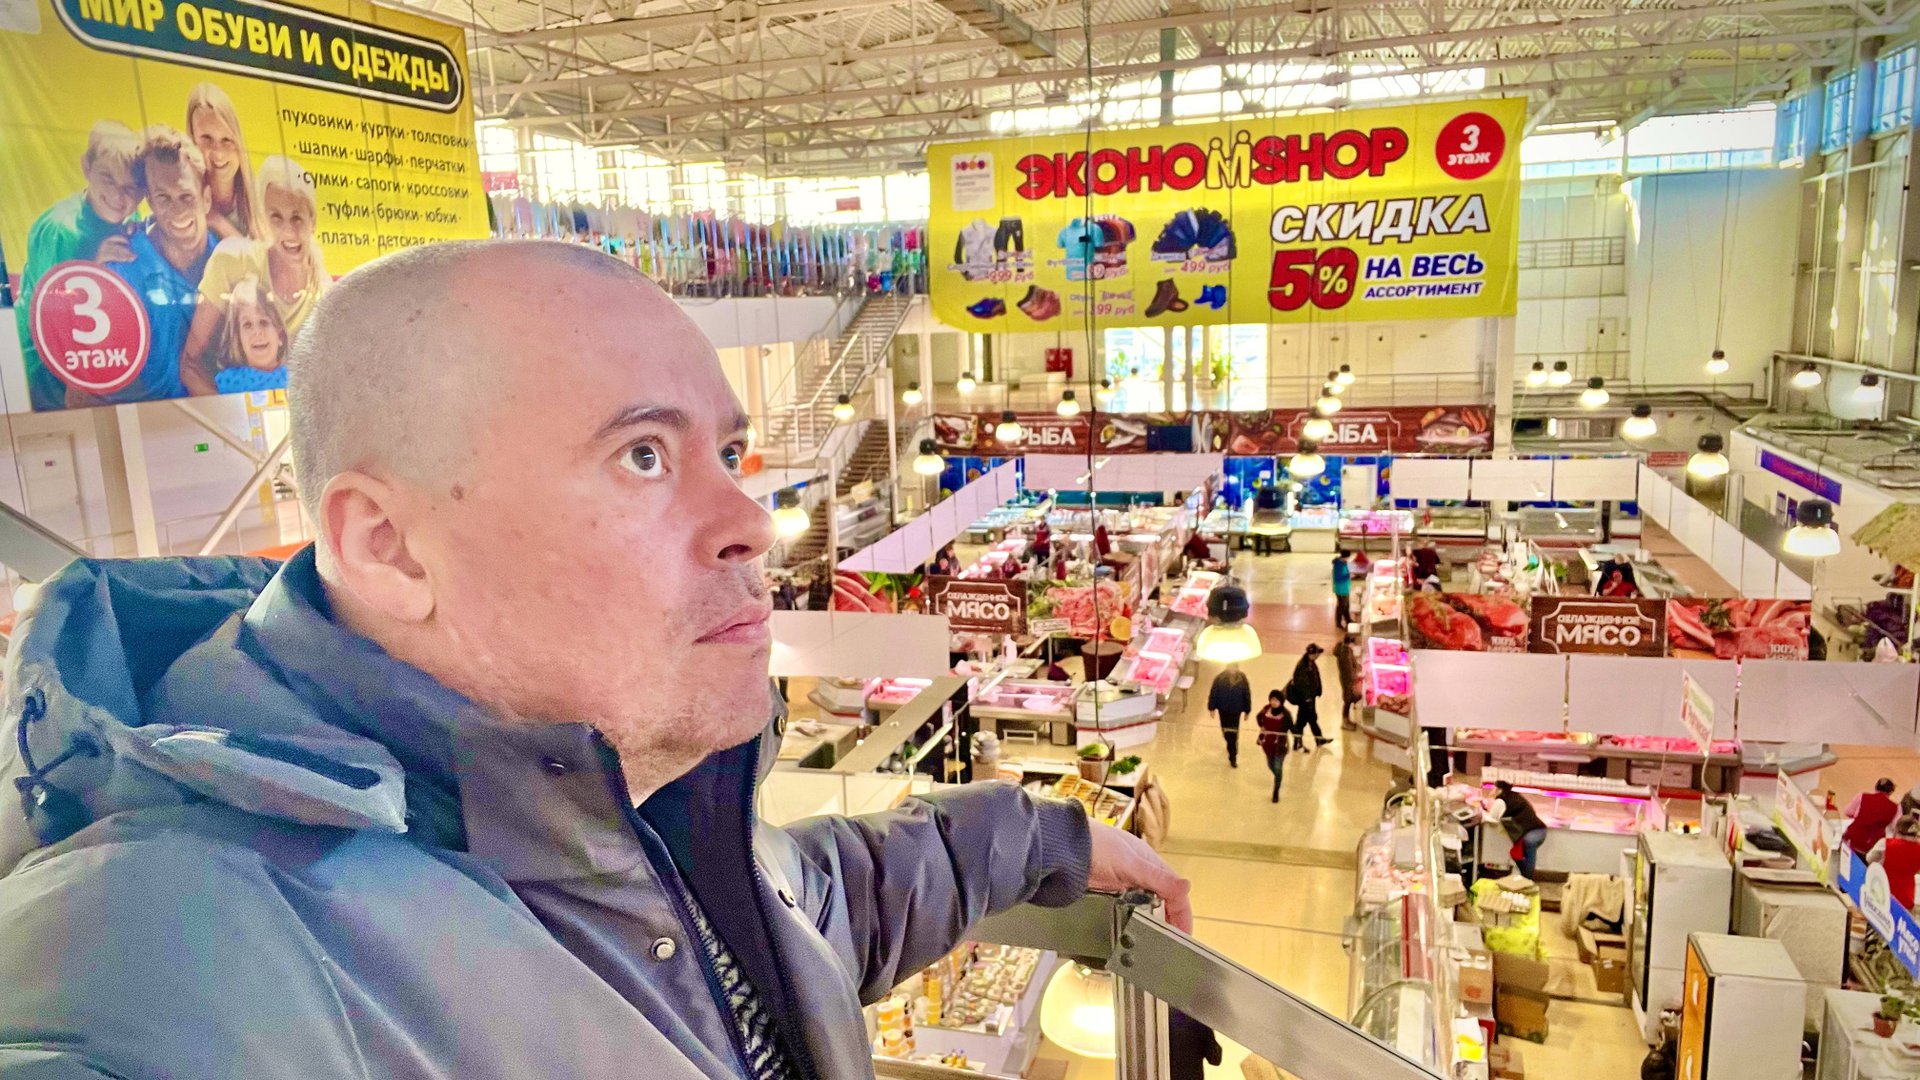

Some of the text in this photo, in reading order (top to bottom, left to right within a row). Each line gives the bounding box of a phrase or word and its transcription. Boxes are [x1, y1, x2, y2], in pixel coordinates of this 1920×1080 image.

[78, 0, 450, 94] МИР ОБУВИ И ОДЕЖДЫ
[282, 109, 470, 148] пуховики куртки толстовки
[1460, 124, 1481, 152] 3
[299, 141, 465, 173] шапки шарфы перчатки
[1448, 151, 1491, 166] этаж
[303, 172, 469, 198] сумки сапоги кроссовки
[326, 200, 458, 223] туфли брюки юбки
[1270, 194, 1491, 245] СКИДКА
[321, 232, 369, 246] платья
[378, 235, 425, 250] детская
[1268, 246, 1484, 312] 50% НА ВЕСЬ
[1365, 282, 1483, 299] АССОРТИМЕНТ
[65, 276, 110, 345] 3
[65, 347, 129, 370] этаж
[1323, 423, 1378, 443] ЫБА
[947, 600, 1010, 620] МЯСО
[1556, 624, 1641, 646] МЯСО
